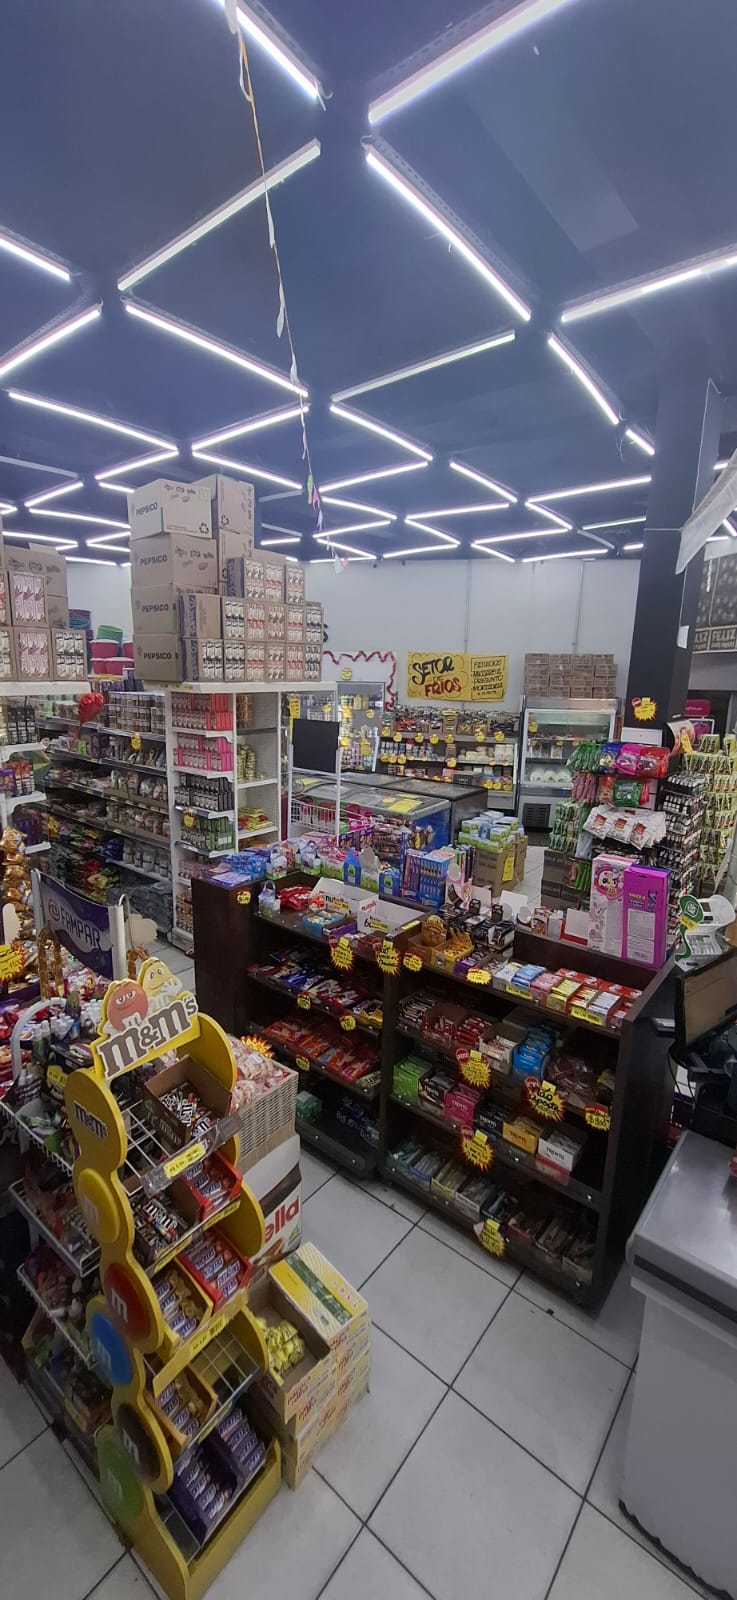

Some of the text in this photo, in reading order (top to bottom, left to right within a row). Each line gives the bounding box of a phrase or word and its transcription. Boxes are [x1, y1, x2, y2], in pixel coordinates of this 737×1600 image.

[136, 502, 158, 516] PEPSICO
[140, 554, 168, 566] PEPSICO
[141, 603, 169, 613] PEPSICO
[712, 629, 735, 641] FELIZ
[143, 651, 172, 660] PEPSICO
[412, 656, 454, 685] SETOR
[424, 677, 461, 697] FRIOS
[60, 906, 101, 951] FAMPAR
[546, 1146, 565, 1160] TRENTO
